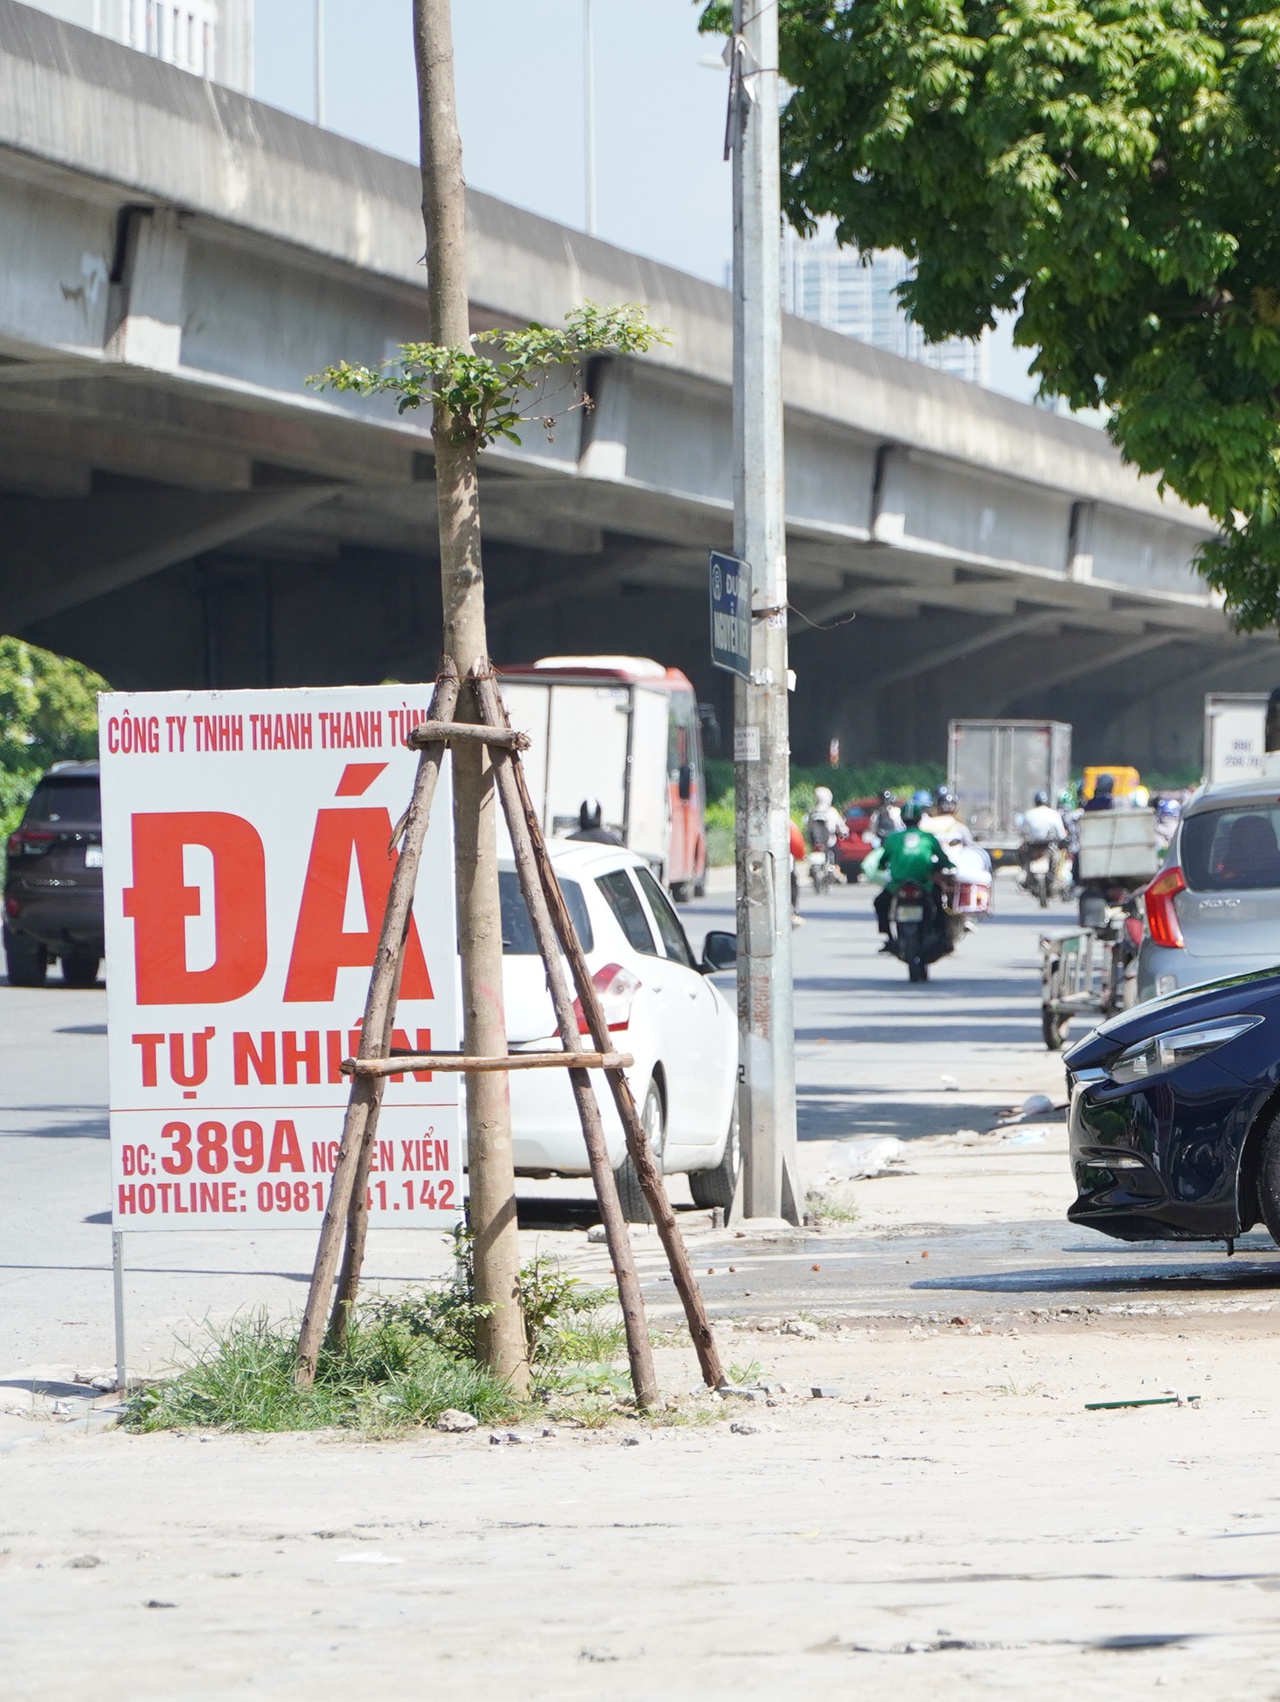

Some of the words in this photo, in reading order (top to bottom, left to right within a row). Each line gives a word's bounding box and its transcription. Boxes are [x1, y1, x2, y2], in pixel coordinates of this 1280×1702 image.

[107, 708, 160, 755] CÔNG
[165, 715, 187, 752] TY
[193, 715, 244, 752] TNHH
[249, 713, 313, 751] THANH
[318, 711, 382, 749] THANH
[122, 762, 435, 1005] ĐÁ
[131, 1026, 216, 1100] TỰ
[160, 1119, 305, 1176] 389A
[400, 1126, 450, 1171] XIỂN
[118, 1182, 247, 1215] HOTLINE:
